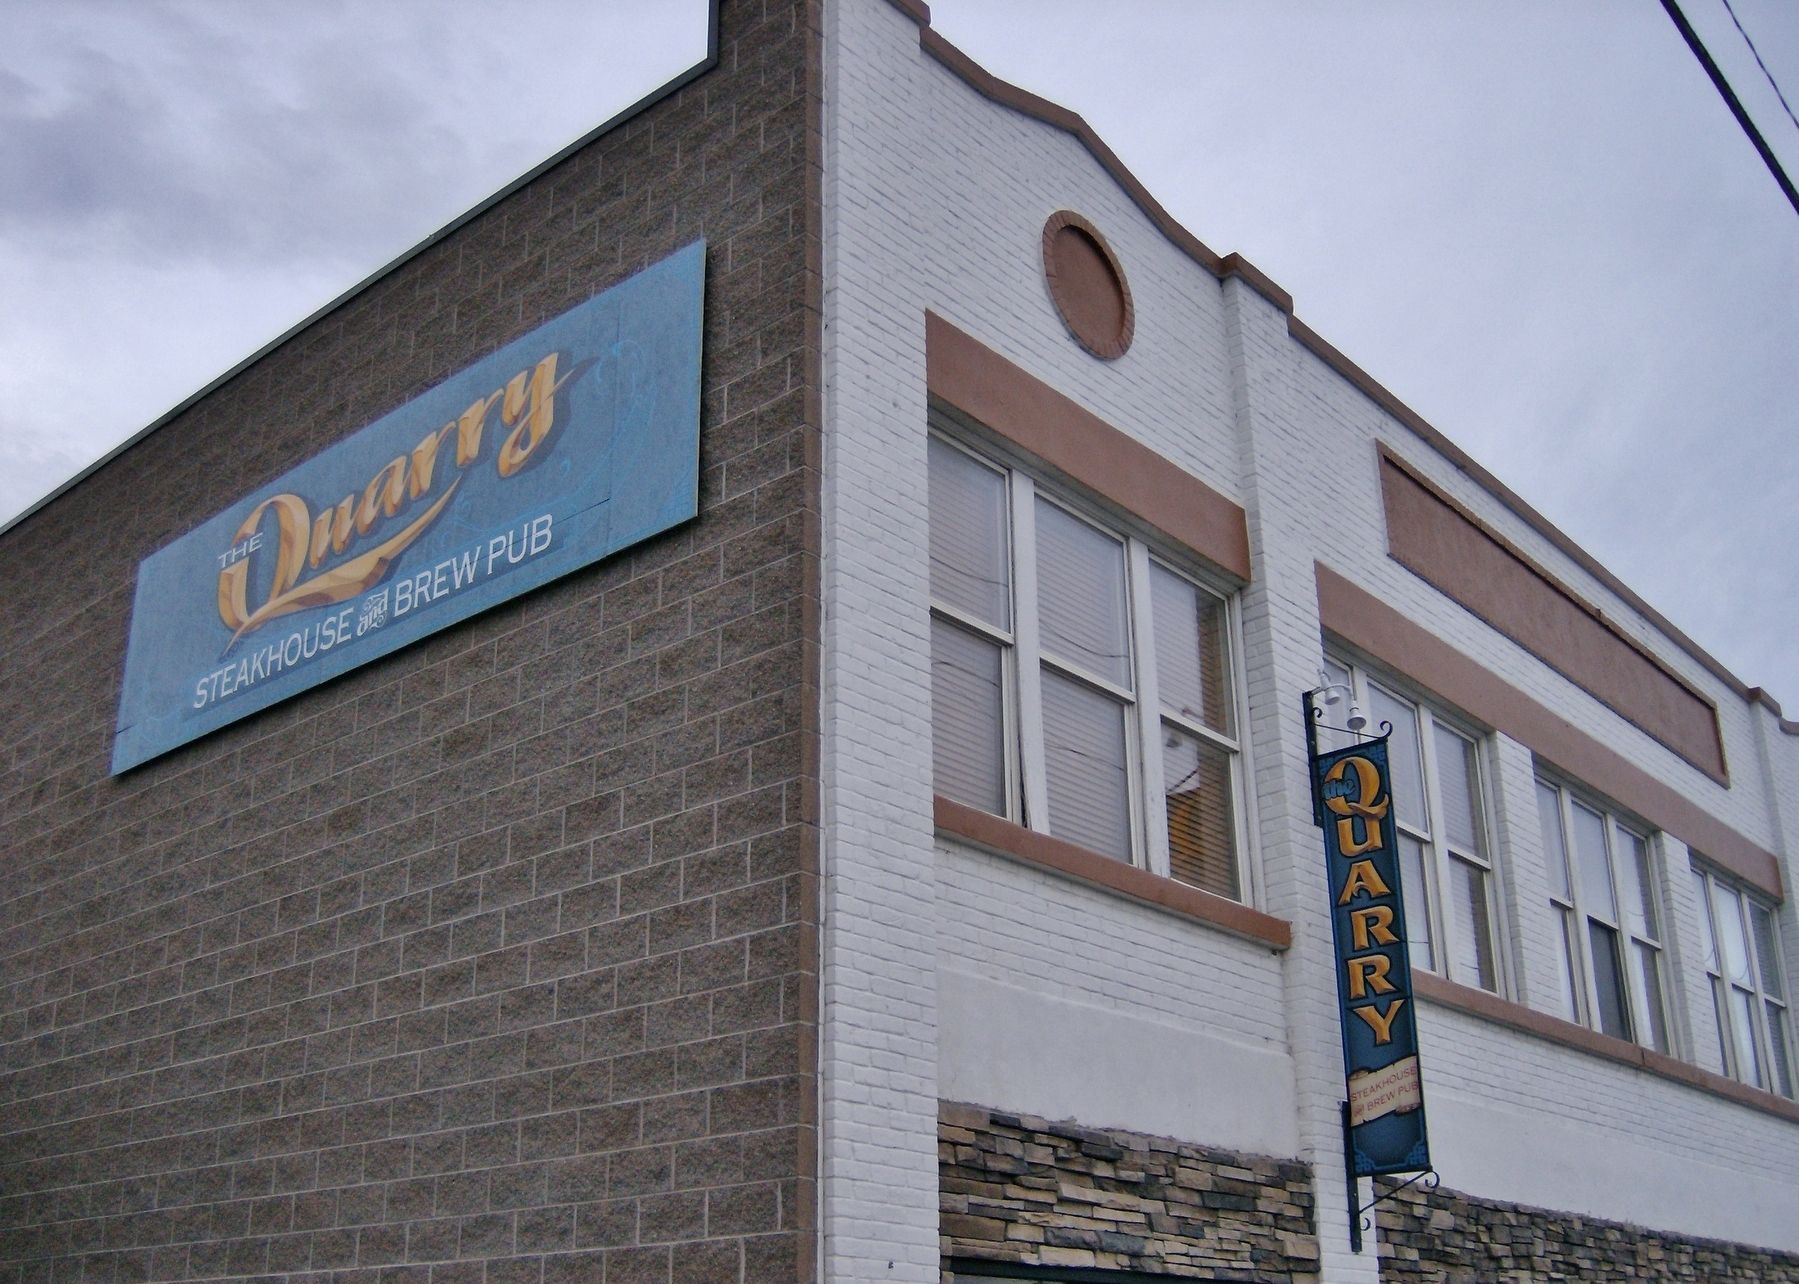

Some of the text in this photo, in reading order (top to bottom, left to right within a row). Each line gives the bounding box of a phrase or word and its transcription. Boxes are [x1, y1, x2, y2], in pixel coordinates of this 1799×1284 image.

[218, 352, 575, 659] Quarry
[218, 532, 263, 569] THE
[193, 606, 355, 709] STEAKHOUSE
[393, 545, 482, 617] BREW
[487, 513, 553, 575] PUB
[1322, 779, 1356, 800] the
[1323, 756, 1405, 1044] QUARRY
[1351, 1066, 1417, 1101] STEAKHOUSE
[1368, 1089, 1396, 1111] BREW
[1398, 1080, 1420, 1096] PUB
